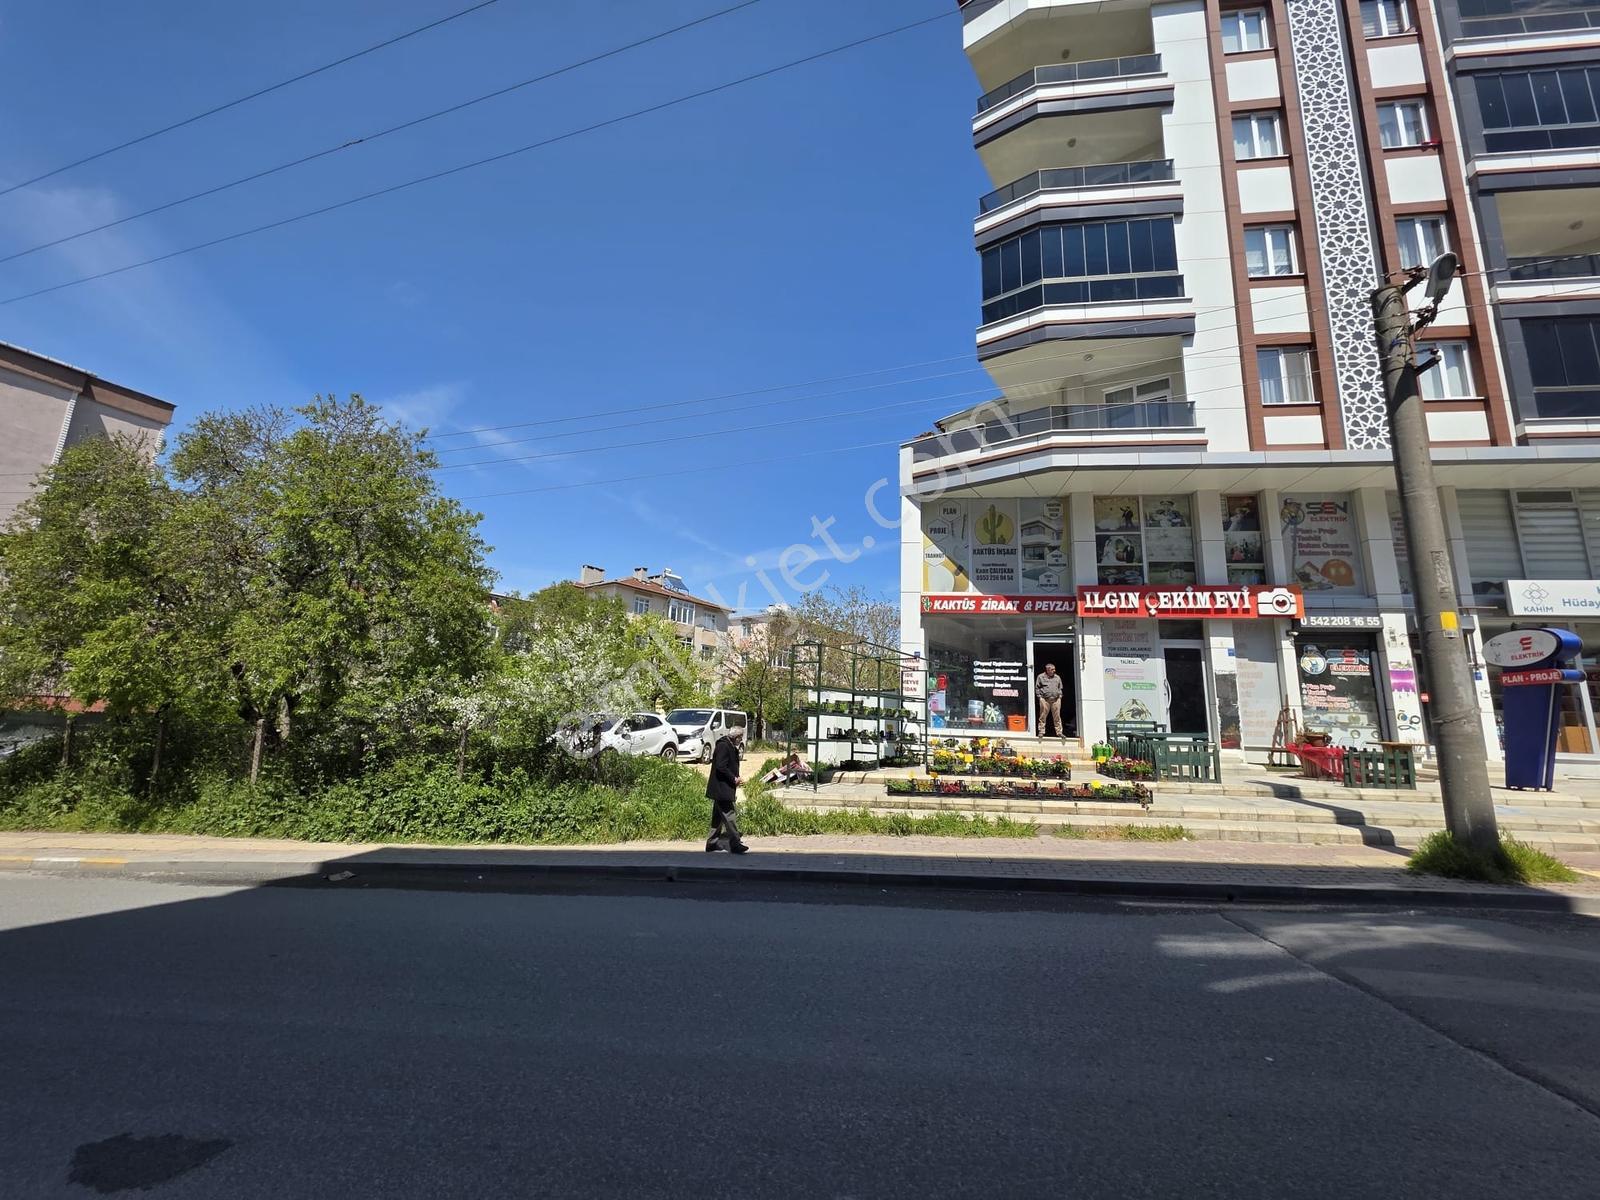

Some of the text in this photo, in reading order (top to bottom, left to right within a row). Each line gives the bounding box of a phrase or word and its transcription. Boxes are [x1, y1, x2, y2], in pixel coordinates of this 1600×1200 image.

[942, 507, 957, 515] PLAN
[929, 527, 947, 535] PROJE
[933, 597, 1076, 612] KAKTÜS ZİRAAT & PEYZAJ
[1084, 585, 1252, 615] ILGIN ÇEKİM EVİ
[1310, 616, 1330, 626] 542
[1331, 616, 1350, 626] 208
[1352, 616, 1364, 626] 16
[1366, 616, 1380, 626] 55
[1511, 650, 1546, 661] ELEKTRİK
[1502, 674, 1524, 684] PLAN
[1530, 672, 1560, 682] PROJE
